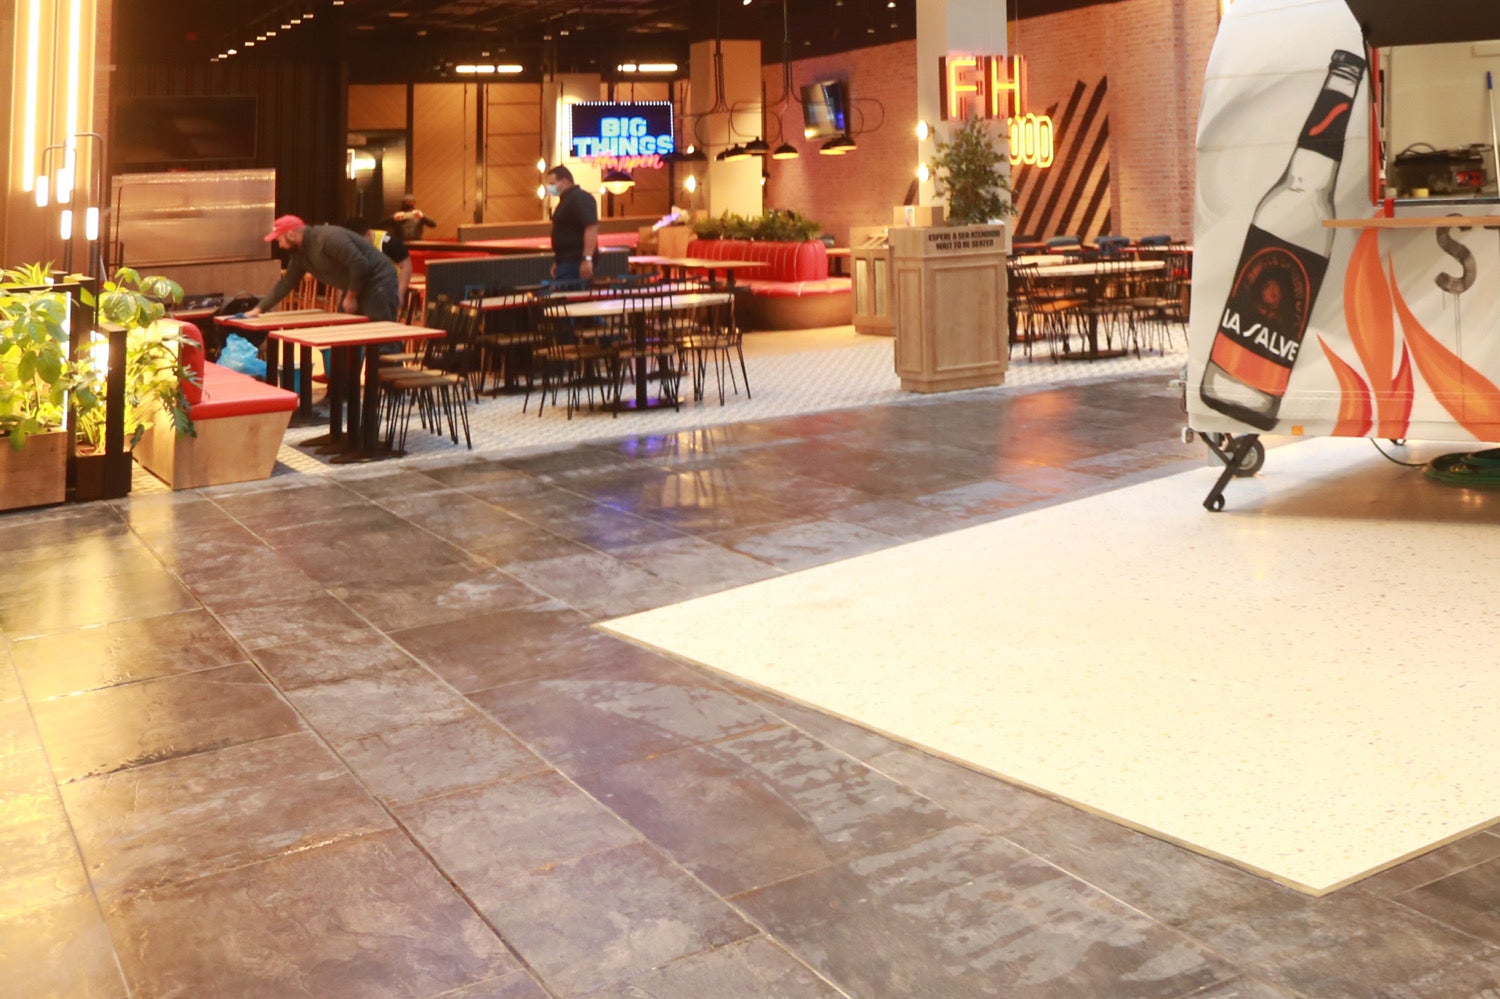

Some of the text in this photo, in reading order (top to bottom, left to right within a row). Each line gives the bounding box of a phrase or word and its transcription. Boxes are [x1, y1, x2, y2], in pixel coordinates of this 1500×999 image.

[939, 55, 1027, 120] FH
[573, 135, 673, 157] THINGS
[600, 117, 647, 137] BIG
[1007, 112, 1054, 168] OOD
[1222, 308, 1299, 361] LA SALVE
